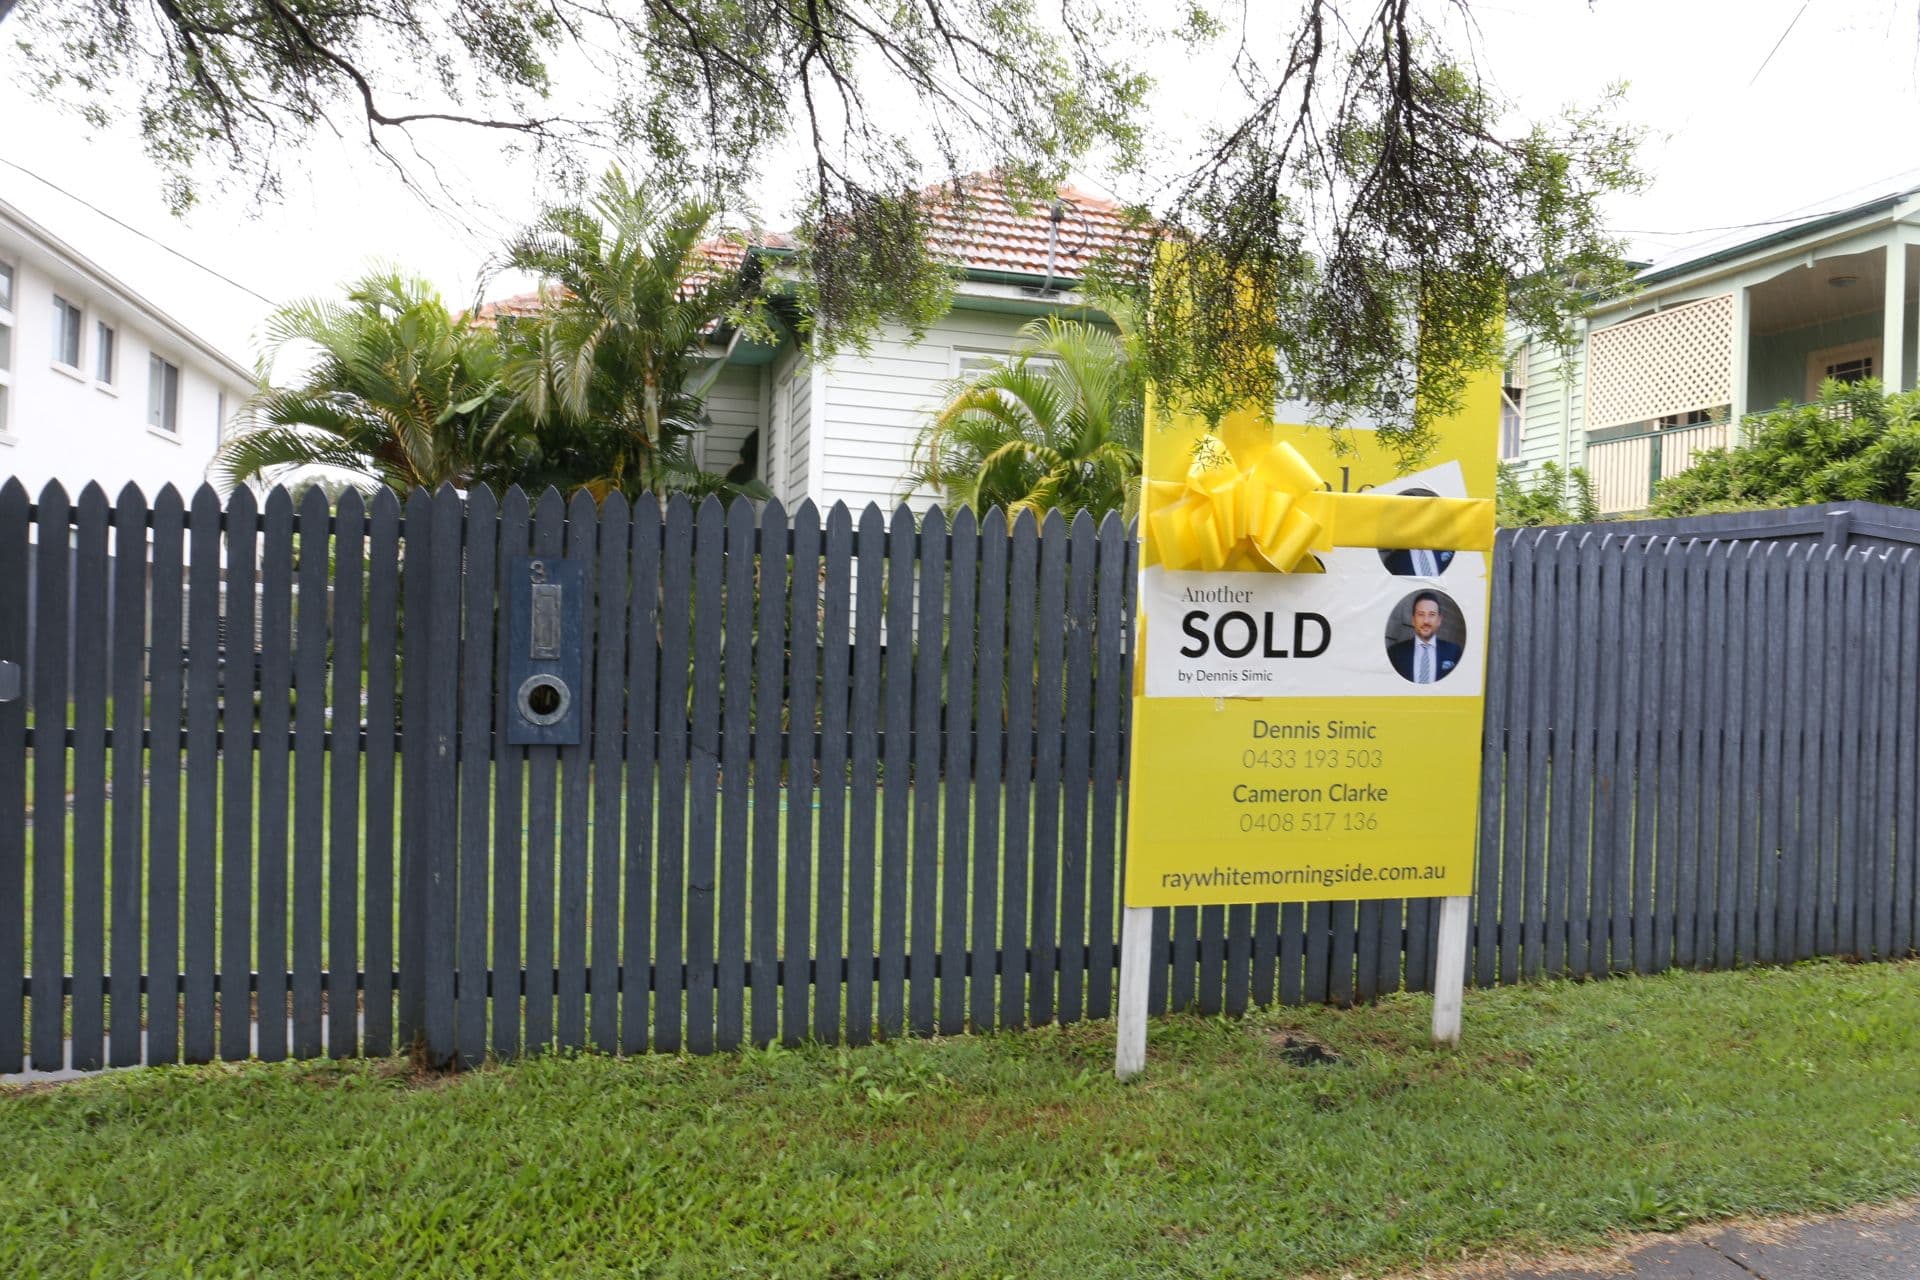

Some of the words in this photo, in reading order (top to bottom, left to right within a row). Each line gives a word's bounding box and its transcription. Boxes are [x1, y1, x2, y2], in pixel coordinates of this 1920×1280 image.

[1182, 585, 1253, 603] Another
[1179, 610, 1332, 659] SOLD
[1178, 669, 1193, 684] by
[1196, 669, 1238, 682] Dennis
[1241, 669, 1273, 682] Simic
[1252, 719, 1321, 740] Dennis
[1326, 719, 1378, 740] Simic
[1242, 748, 1297, 769] 0433
[1304, 748, 1339, 769] 193
[1345, 748, 1383, 769] 503
[1232, 783, 1322, 804] Cameron
[1328, 782, 1389, 803] Clarke
[1239, 812, 1295, 833] 0408
[1300, 812, 1336, 832] 517
[1342, 811, 1379, 832] 136
[1161, 863, 1447, 891] raywhitemorningside.com.au
